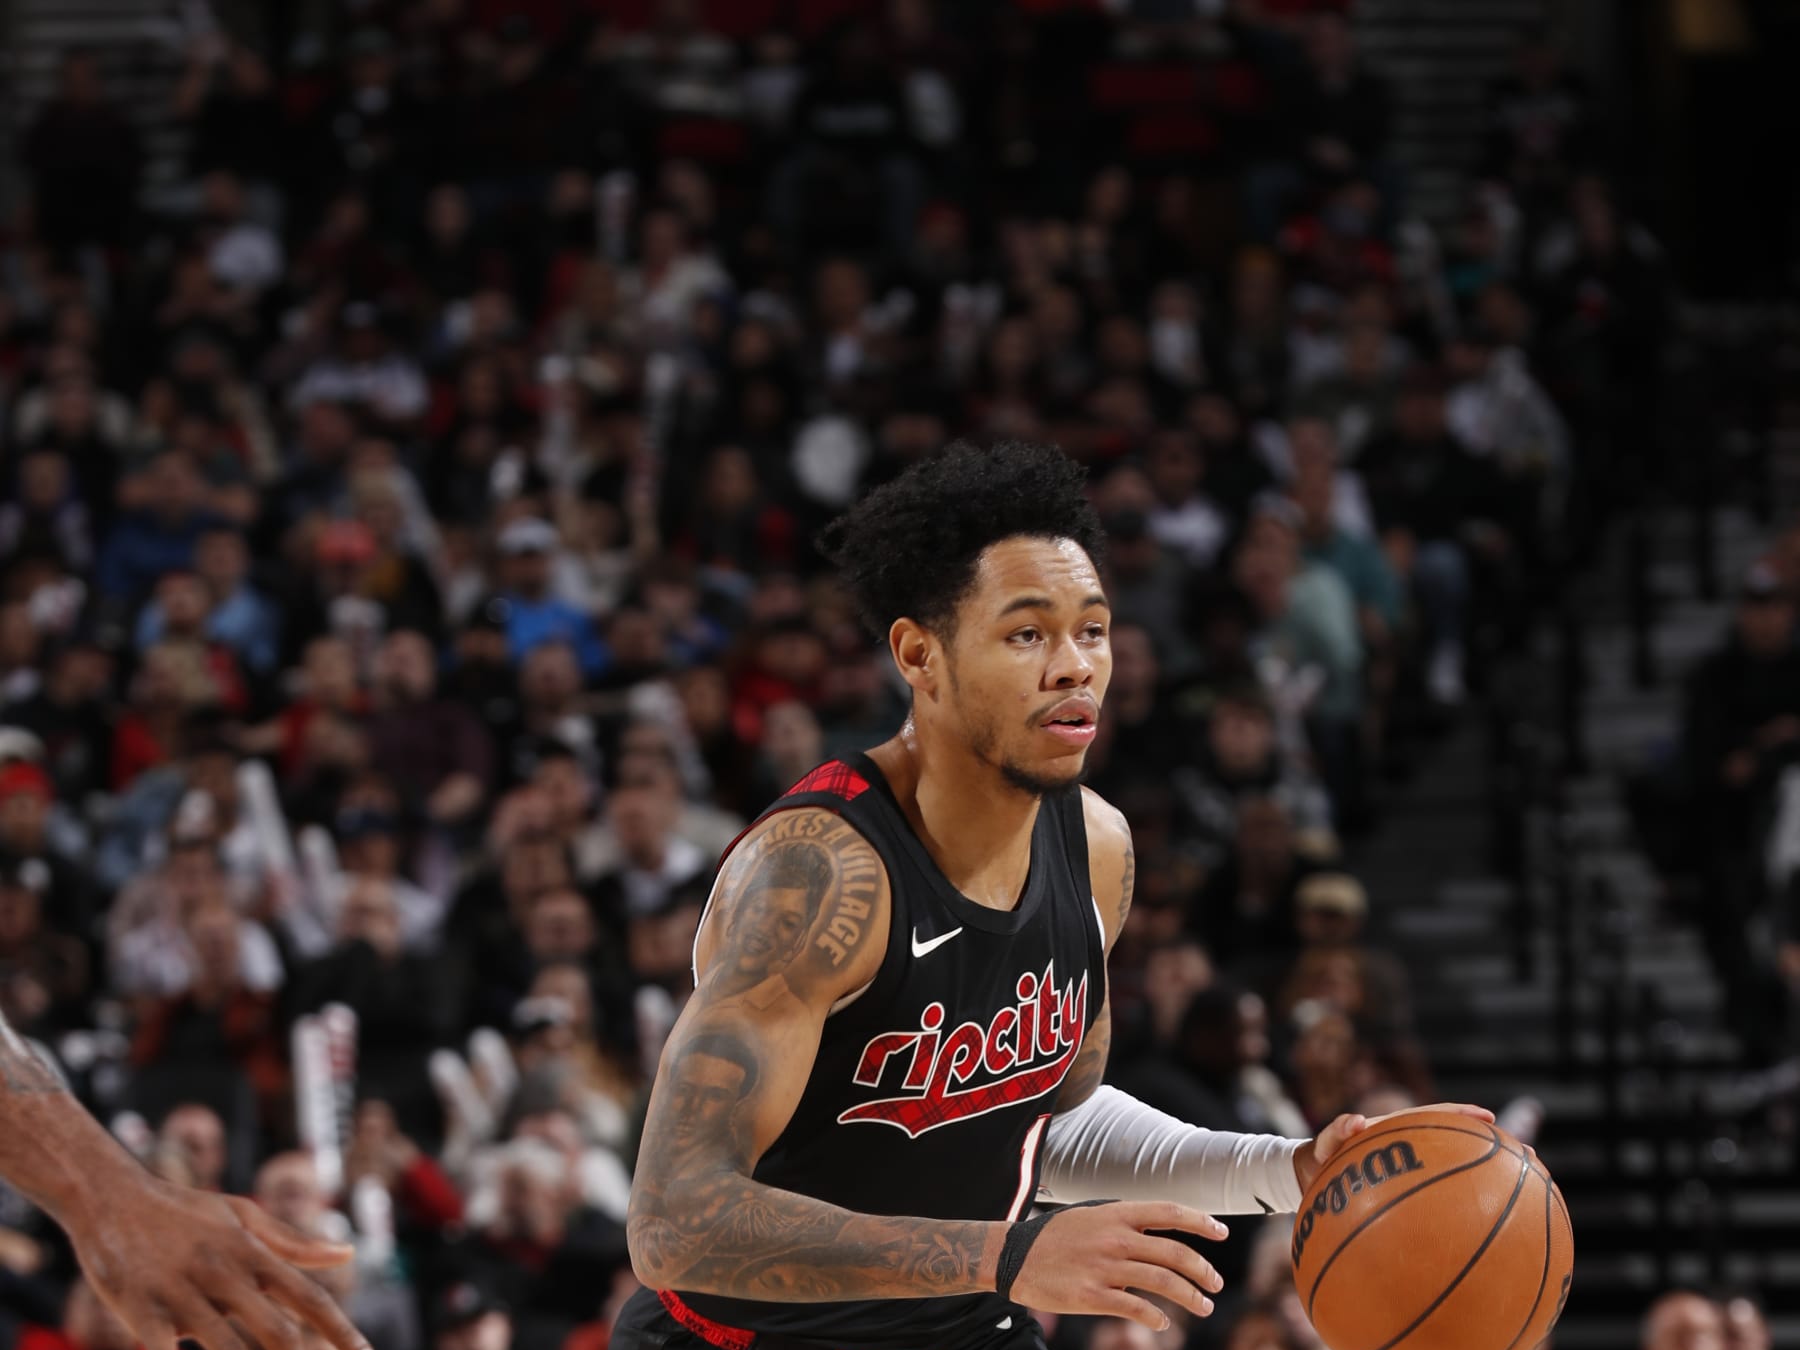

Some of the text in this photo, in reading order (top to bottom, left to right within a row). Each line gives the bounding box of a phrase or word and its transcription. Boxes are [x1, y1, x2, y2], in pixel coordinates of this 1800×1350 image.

[745, 811, 878, 967] AKES A VILLAGE
[837, 957, 1088, 1139] ripcity
[1291, 1140, 1424, 1270] Wilson
